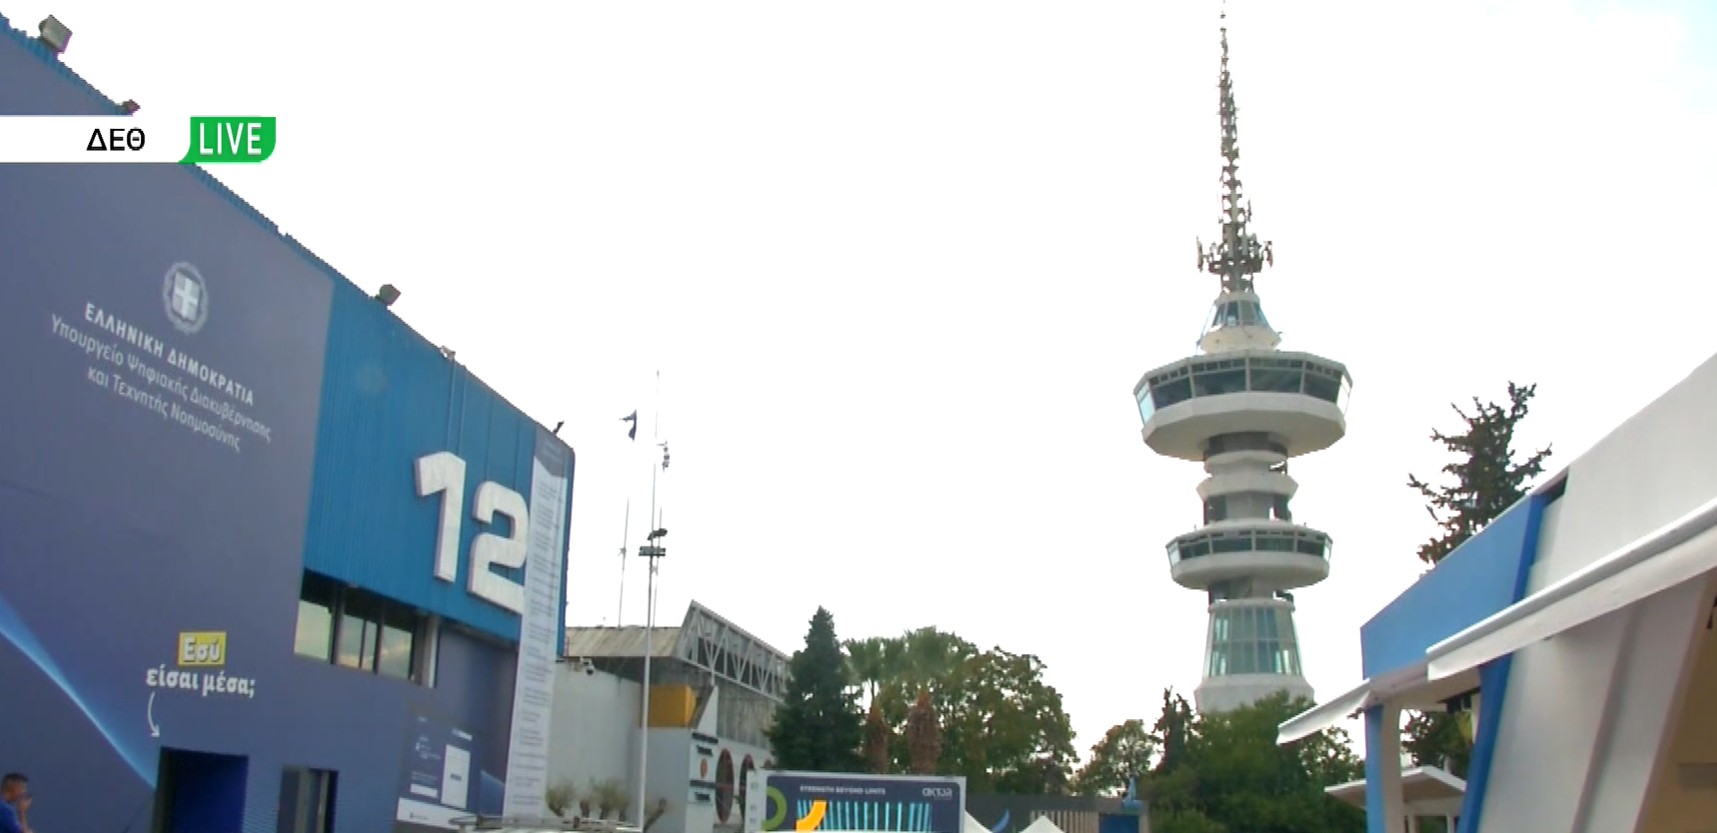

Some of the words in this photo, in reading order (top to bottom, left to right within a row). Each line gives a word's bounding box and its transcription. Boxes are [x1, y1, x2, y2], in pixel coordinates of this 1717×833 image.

[52, 313, 124, 366] Υπουργείο
[128, 353, 189, 401] Ψηφιακής
[190, 386, 271, 442] Διακυβέρνησης
[85, 302, 164, 358] ΕΛΛΗΝΙΚΗ
[167, 348, 254, 406] ΔΗΜΟΚΡΑΤΙΑ
[87, 366, 109, 388] και
[113, 374, 168, 419] Τεχνητής
[171, 402, 240, 453] Νοημοσύνης
[414, 451, 529, 617] 12
[146, 663, 199, 690] είσαι
[202, 670, 255, 699] μέσα;
[183, 637, 221, 662] Εσύ
